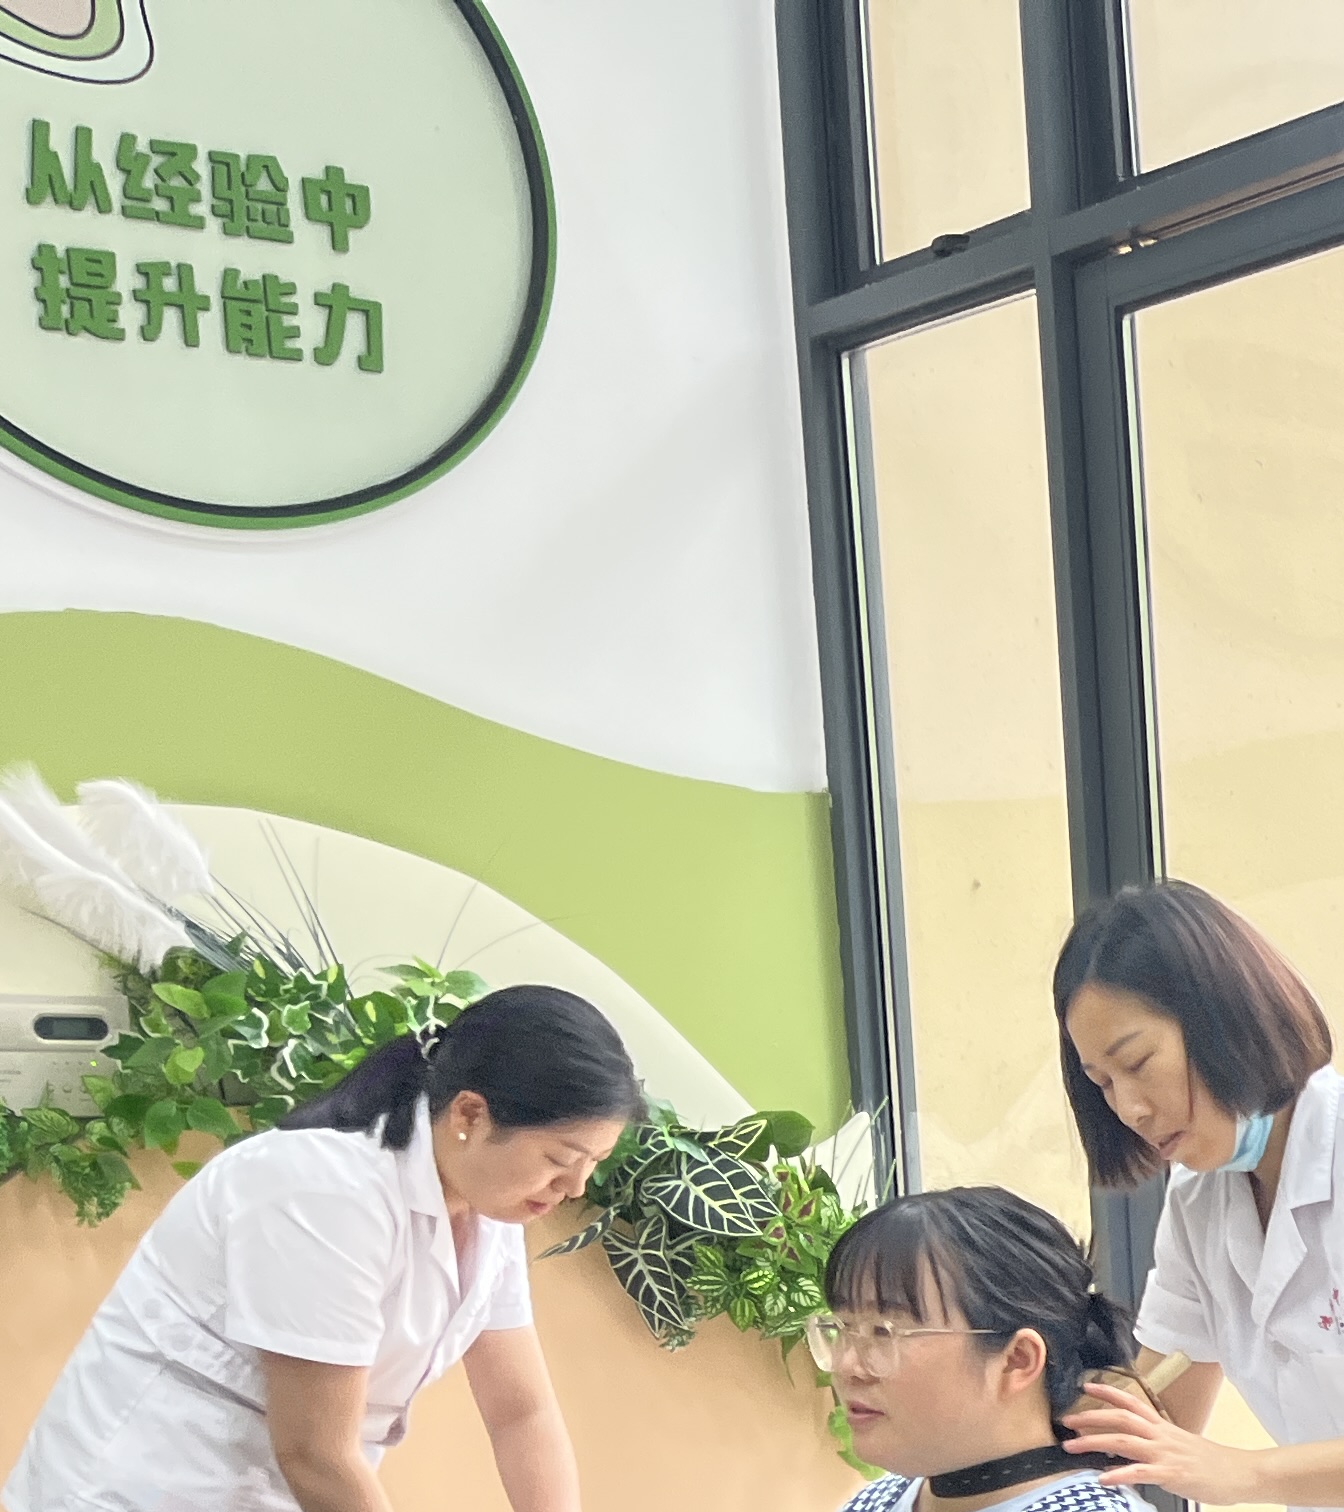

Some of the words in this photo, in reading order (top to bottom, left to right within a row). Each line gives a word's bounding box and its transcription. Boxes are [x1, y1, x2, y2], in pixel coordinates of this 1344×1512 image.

[26, 118, 371, 253] 从经验中
[31, 243, 384, 374] 提升能力
